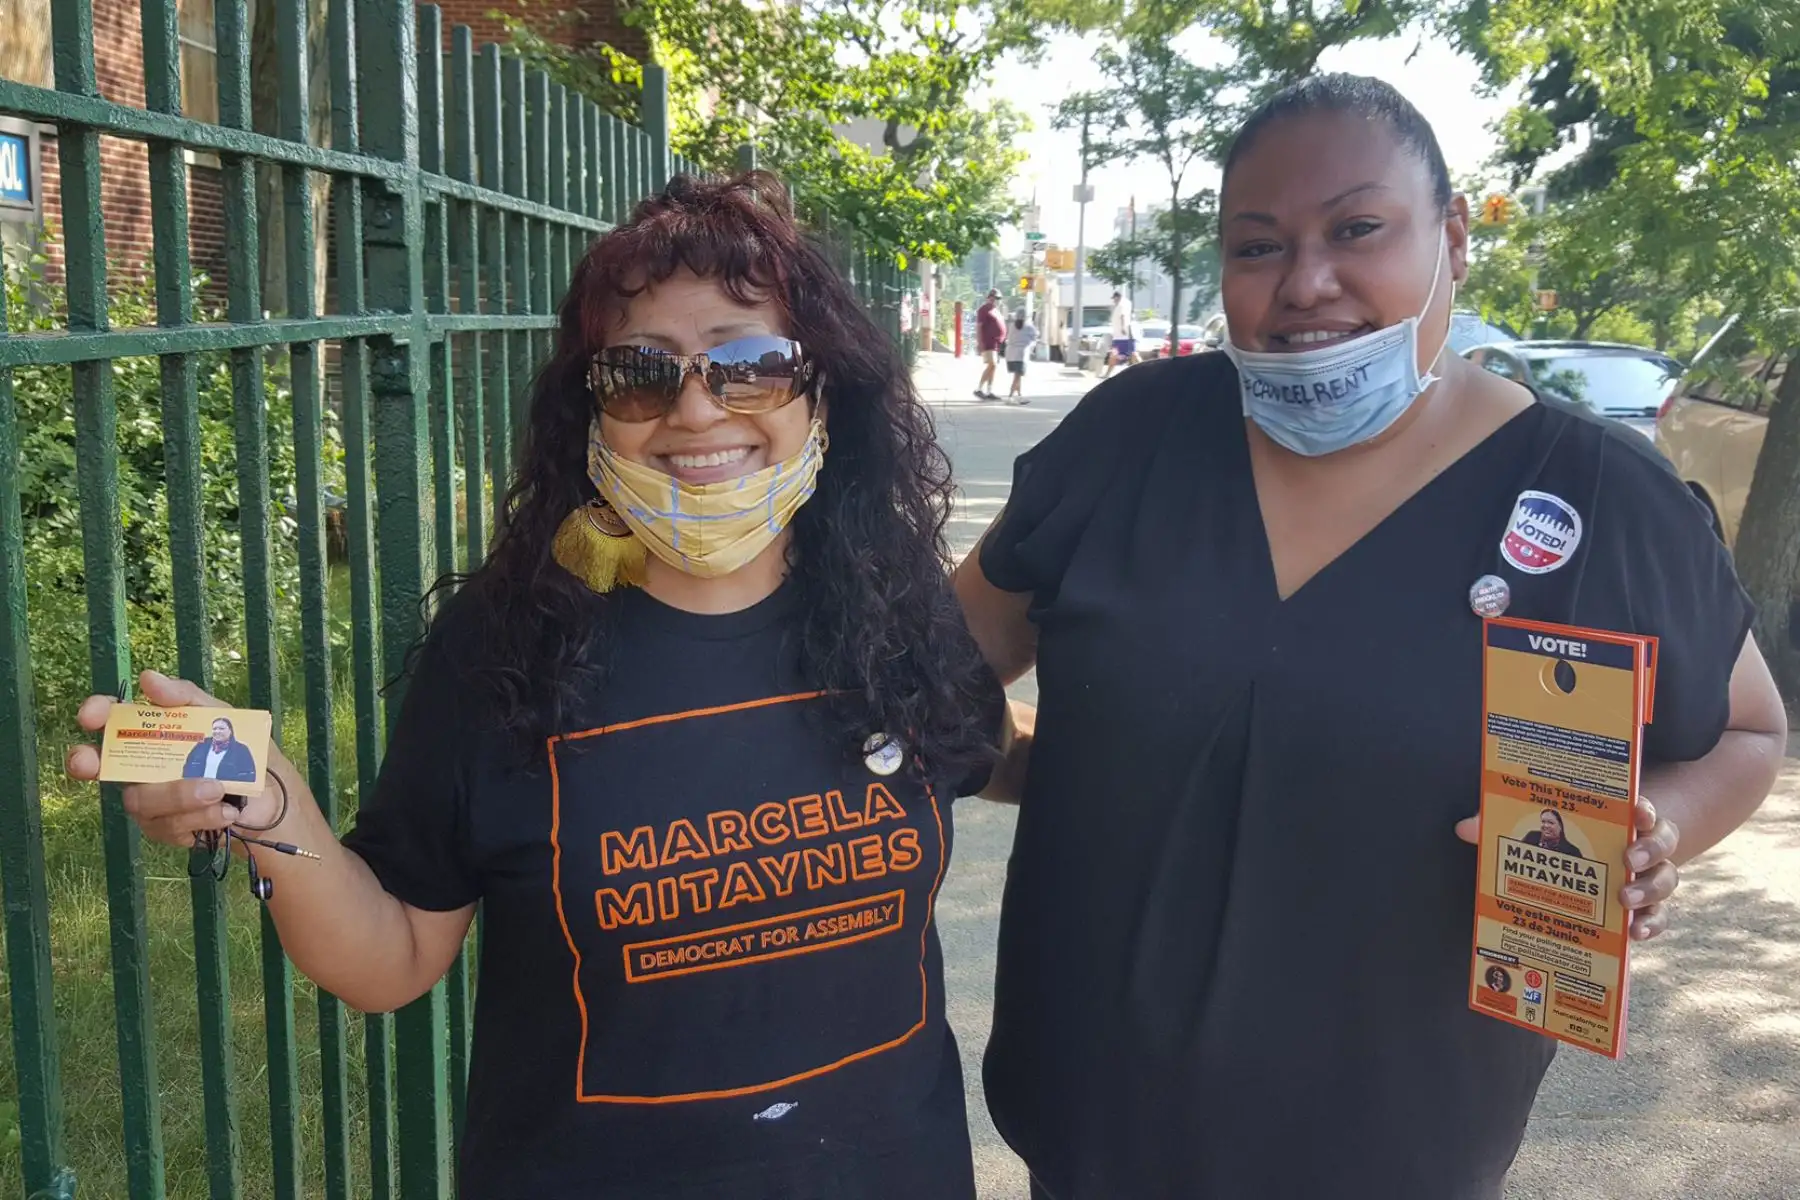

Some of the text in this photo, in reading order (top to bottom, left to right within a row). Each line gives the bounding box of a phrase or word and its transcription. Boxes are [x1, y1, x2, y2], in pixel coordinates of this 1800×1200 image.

[1528, 634, 1587, 658] VOTE!
[137, 710, 189, 719] Vote Vote
[141, 721, 182, 731] for para
[1501, 775, 1528, 789] Vote
[1529, 782, 1553, 795] This
[1529, 793, 1558, 808] June
[600, 782, 907, 876] MARCELA
[1506, 844, 1598, 880] MARCELA
[595, 828, 923, 930] MITAYNES
[1504, 860, 1599, 896] MITAYNES
[1496, 899, 1523, 915] Vote
[1525, 910, 1551, 923] este
[1503, 926, 1518, 935] Find
[1519, 931, 1536, 941] your
[1513, 916, 1526, 927] 23
[1528, 920, 1544, 933] de
[639, 904, 894, 970] DEMOCRAT FOR ASSEMBLY
